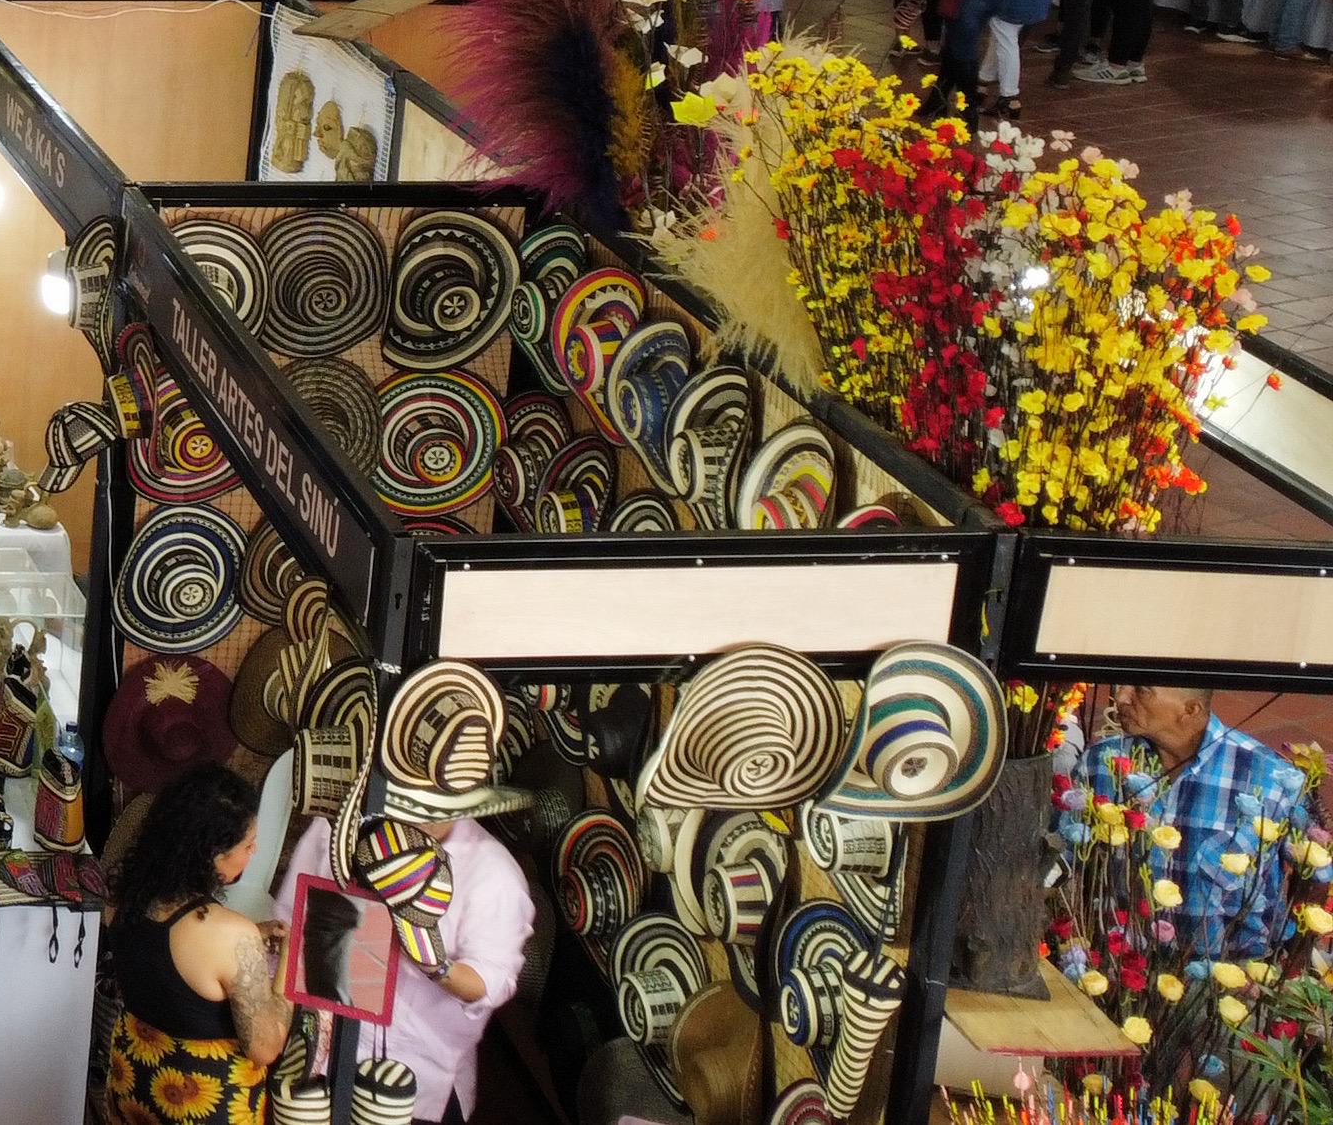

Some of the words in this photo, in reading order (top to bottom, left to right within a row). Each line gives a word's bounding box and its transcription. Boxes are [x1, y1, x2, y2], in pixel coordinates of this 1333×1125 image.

[5, 96, 24, 141] WE
[24, 121, 36, 150] &
[172, 297, 217, 388] TALLER
[217, 371, 264, 461] ARTES
[264, 429, 295, 507] DEL
[299, 472, 341, 559] SINÚ
